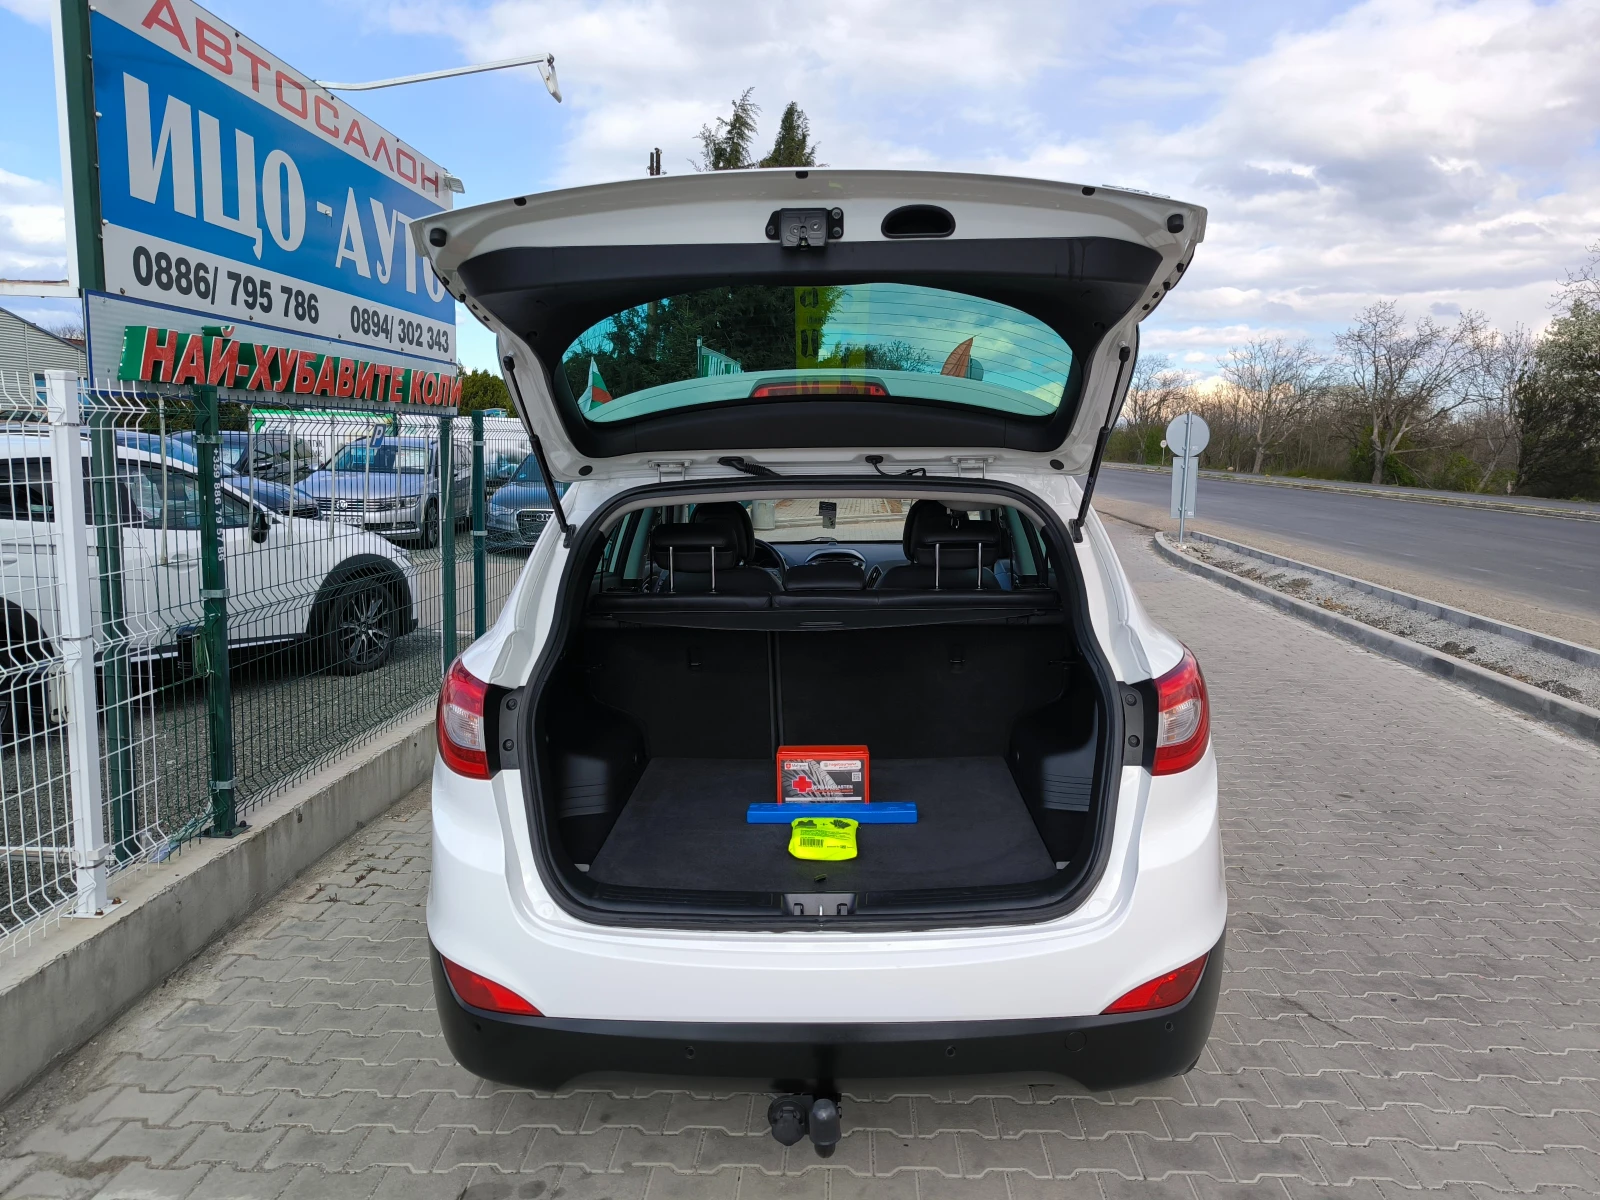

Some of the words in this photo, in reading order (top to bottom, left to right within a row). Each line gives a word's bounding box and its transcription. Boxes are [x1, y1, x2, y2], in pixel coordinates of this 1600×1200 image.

[141, 0, 439, 199] АВТОСАЛОН
[132, 246, 219, 306] 0886/
[226, 271, 273, 314] 795
[280, 286, 320, 325] 786
[350, 305, 394, 345] 0894/
[397, 318, 424, 348] 302
[427, 324, 450, 354] 343
[140, 325, 405, 403] НАЙ-ХУБАВИТЕ
[408, 368, 463, 408] КОЛИ
[372, 426, 384, 446] P
[212, 447, 220, 478] +359
[213, 482, 222, 505] 886
